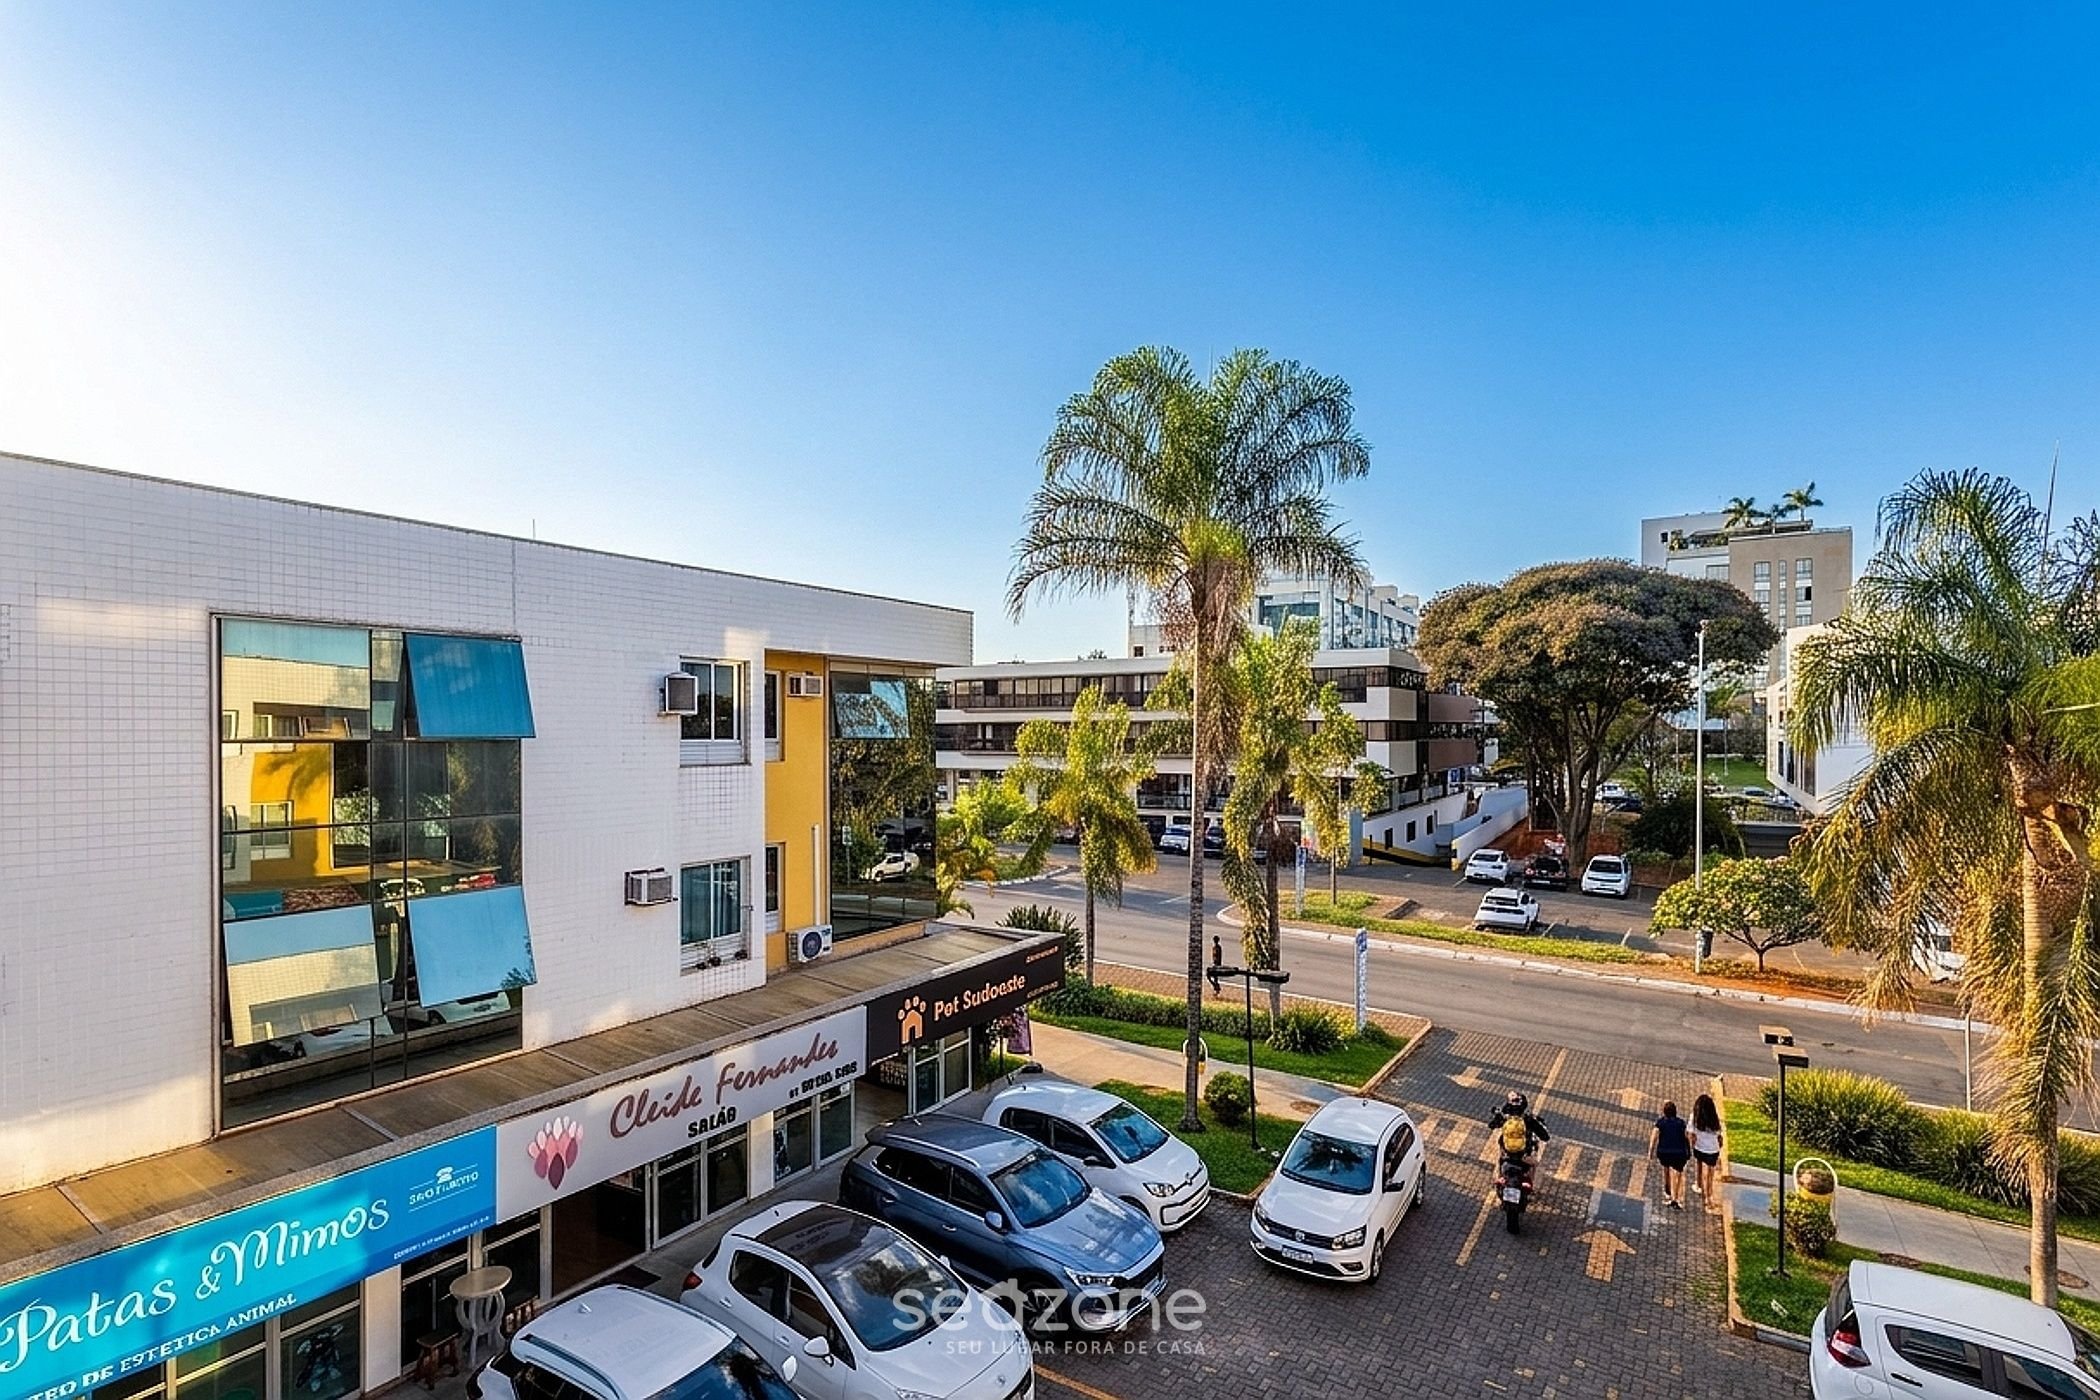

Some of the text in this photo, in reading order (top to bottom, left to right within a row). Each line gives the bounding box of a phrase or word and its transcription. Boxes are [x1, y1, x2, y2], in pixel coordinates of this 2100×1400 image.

[610, 1075, 702, 1138] Cleide
[715, 1032, 839, 1105] Fernandes
[0, 1279, 177, 1372] Patas
[195, 1265, 221, 1299] &
[210, 1200, 390, 1286] Mimos
[225, 1293, 297, 1330] ANIMAL
